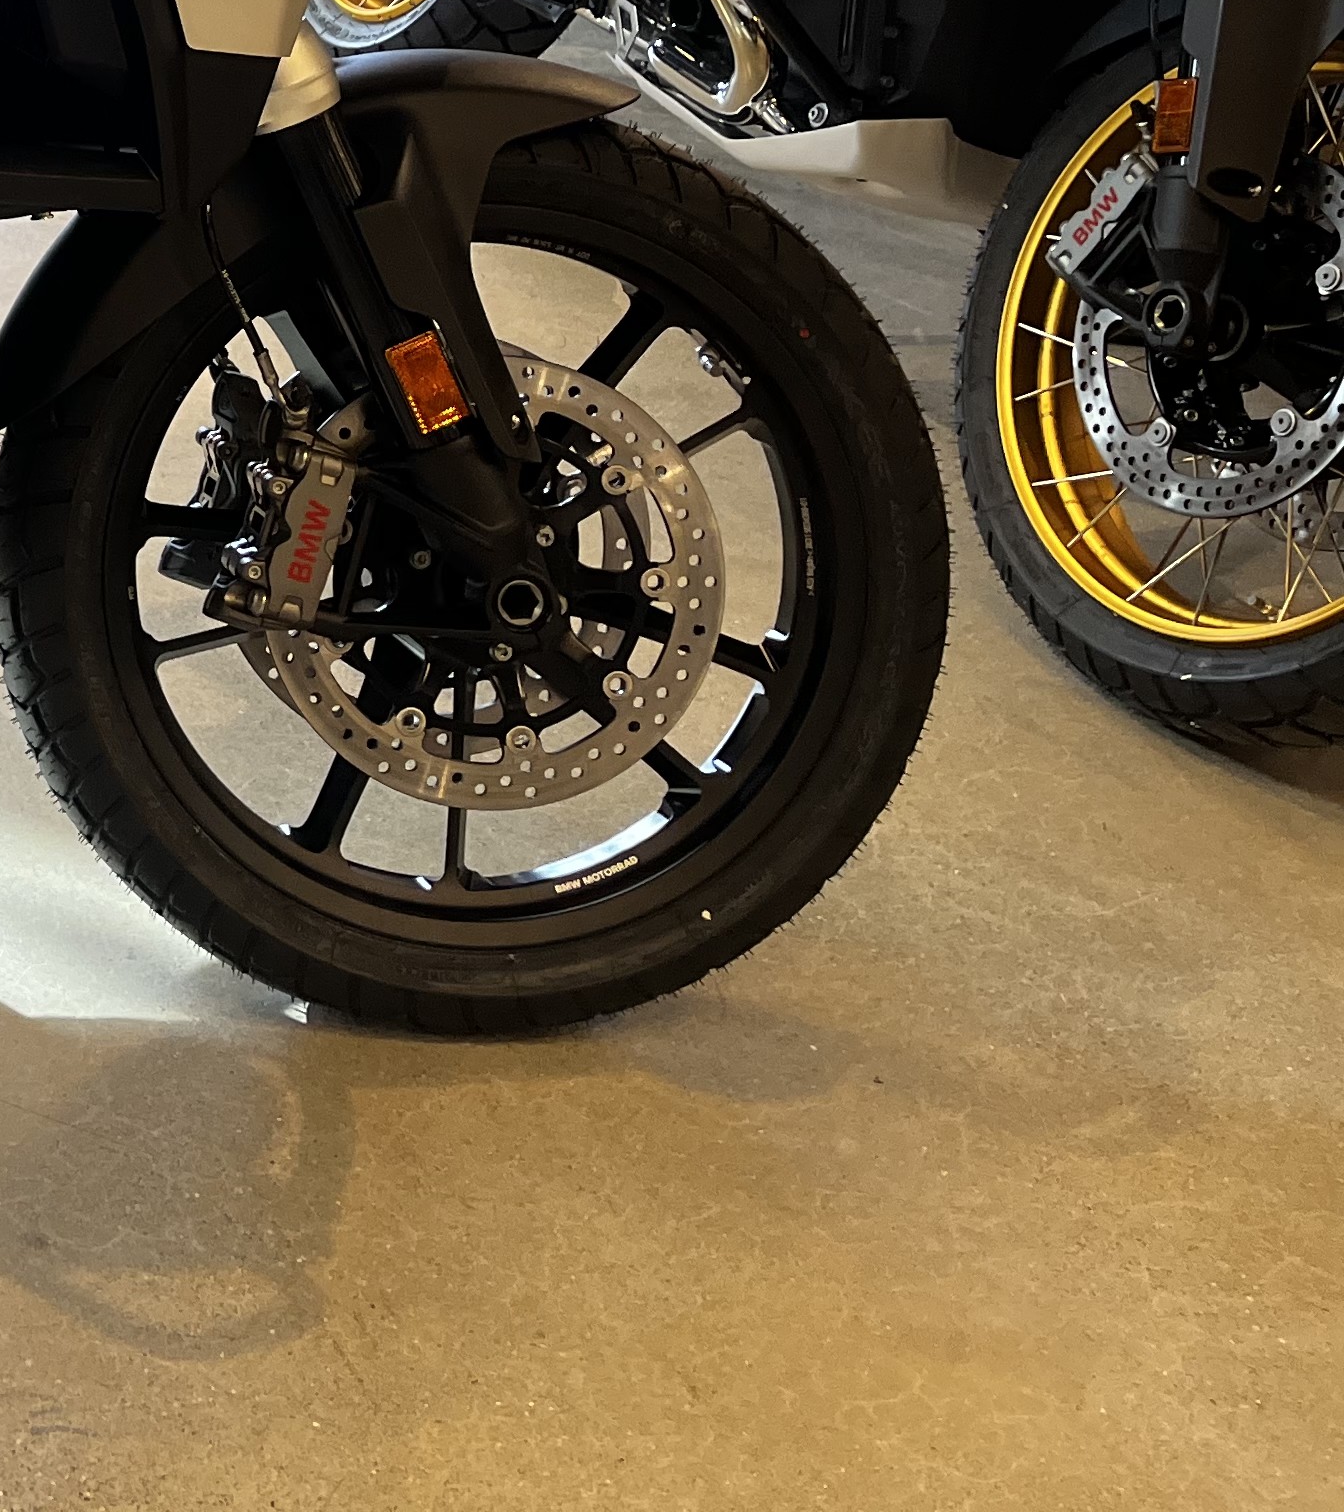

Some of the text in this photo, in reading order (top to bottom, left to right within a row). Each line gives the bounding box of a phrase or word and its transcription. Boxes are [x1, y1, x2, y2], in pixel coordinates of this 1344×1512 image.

[1072, 186, 1119, 247] BMW
[286, 497, 332, 584] BMW
[554, 855, 639, 894] BMW MOTORRAD
